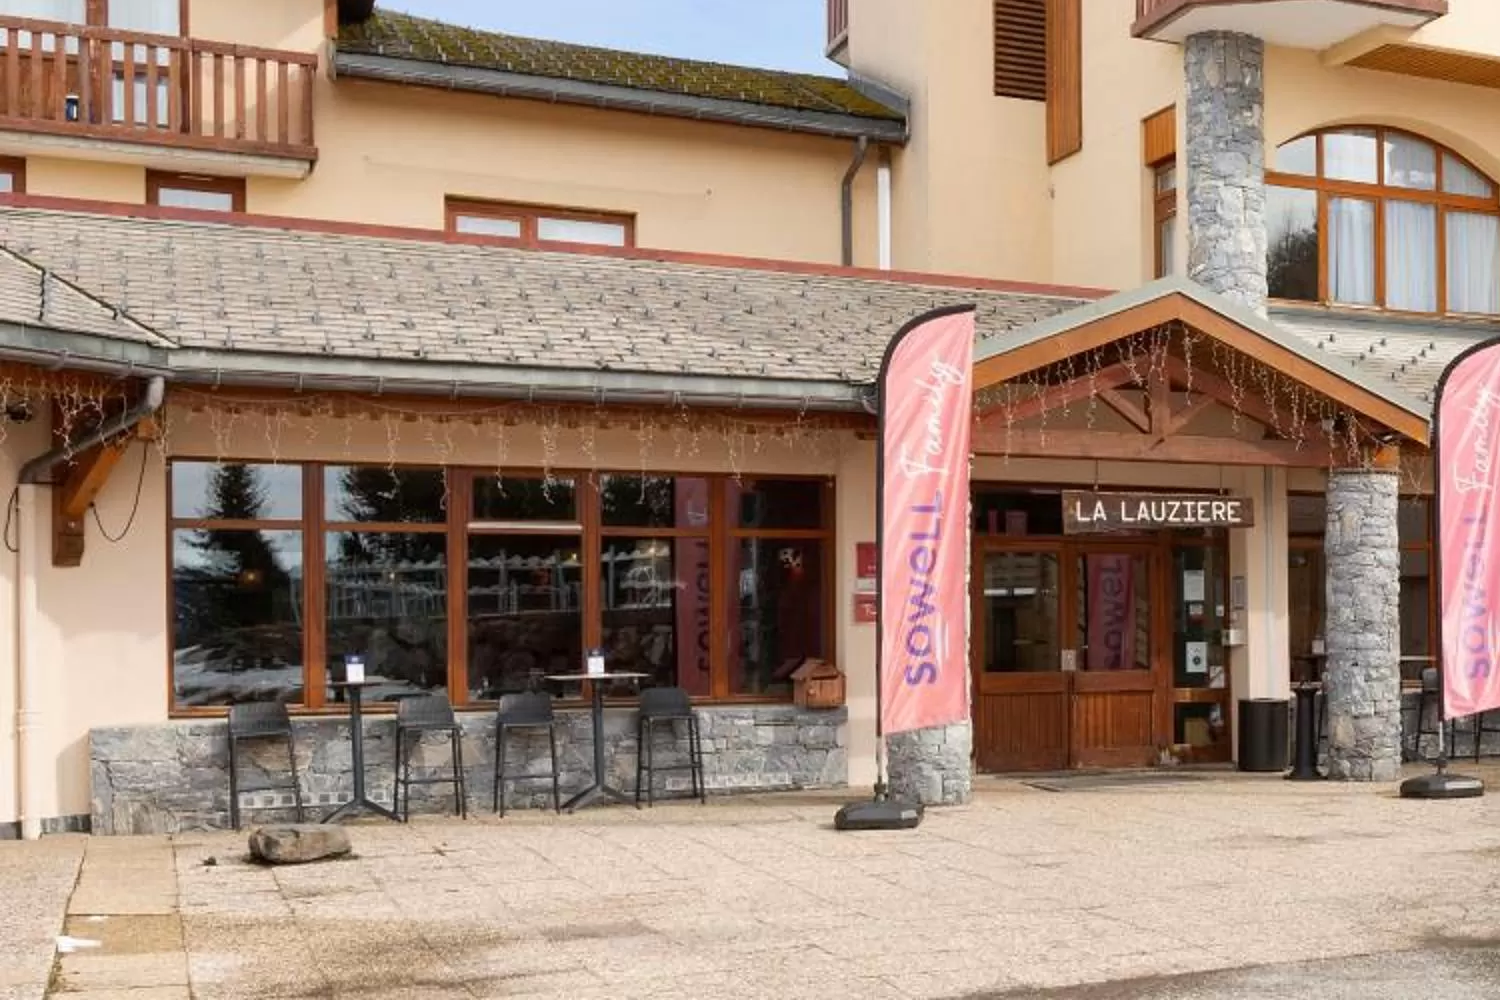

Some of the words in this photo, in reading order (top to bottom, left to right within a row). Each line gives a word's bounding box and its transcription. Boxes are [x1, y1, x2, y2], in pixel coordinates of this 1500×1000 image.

[901, 354, 964, 479] Family
[1075, 500, 1107, 522] LA
[1120, 500, 1242, 523] LAUZIERE
